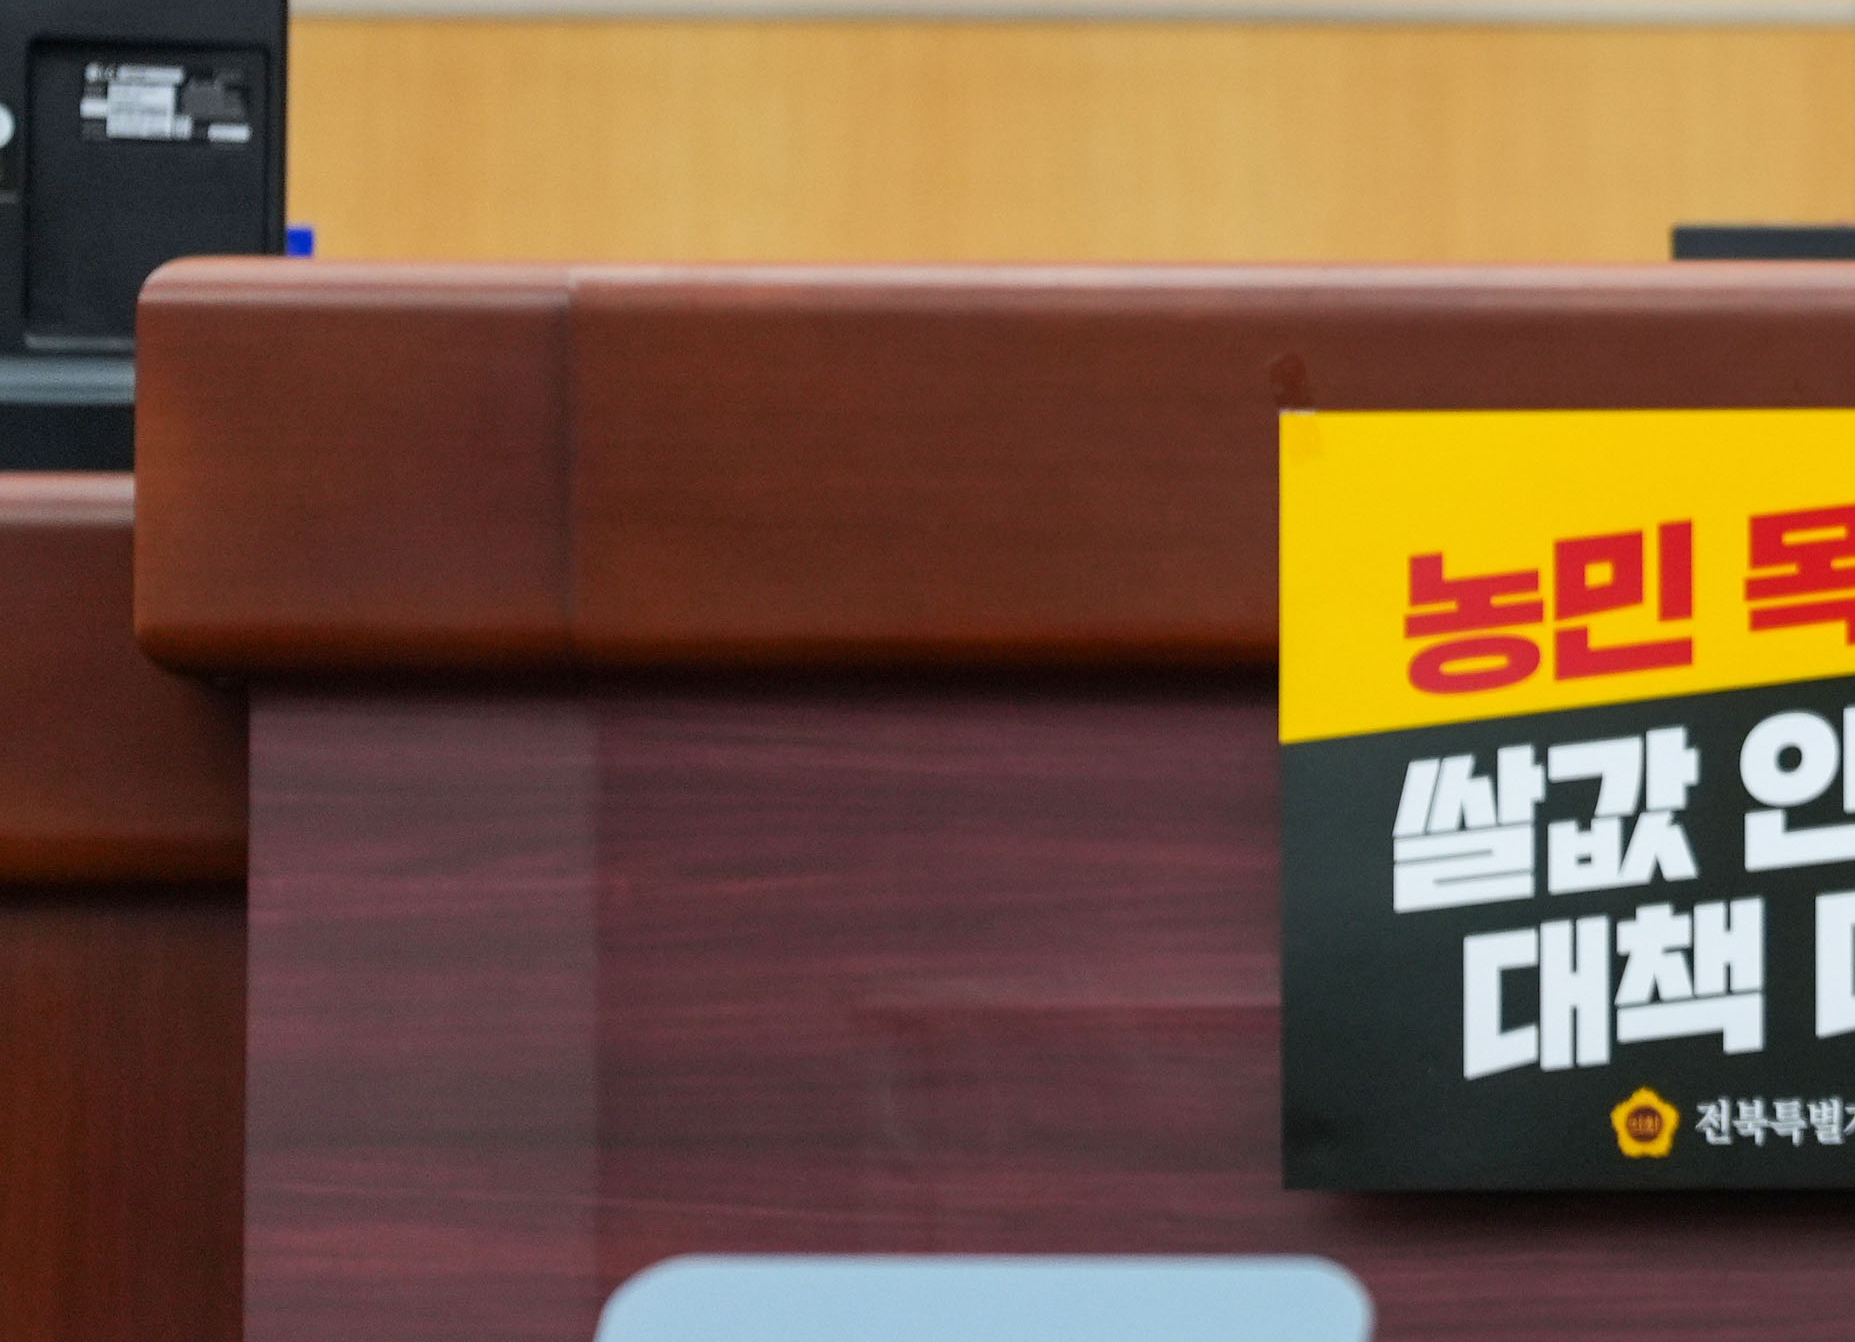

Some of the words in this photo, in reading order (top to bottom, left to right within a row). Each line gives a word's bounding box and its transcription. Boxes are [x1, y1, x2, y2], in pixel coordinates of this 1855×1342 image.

[1405, 520, 1694, 695] 농민
[1393, 725, 1699, 913] 쌀값
[1463, 897, 1765, 1080] 대책
